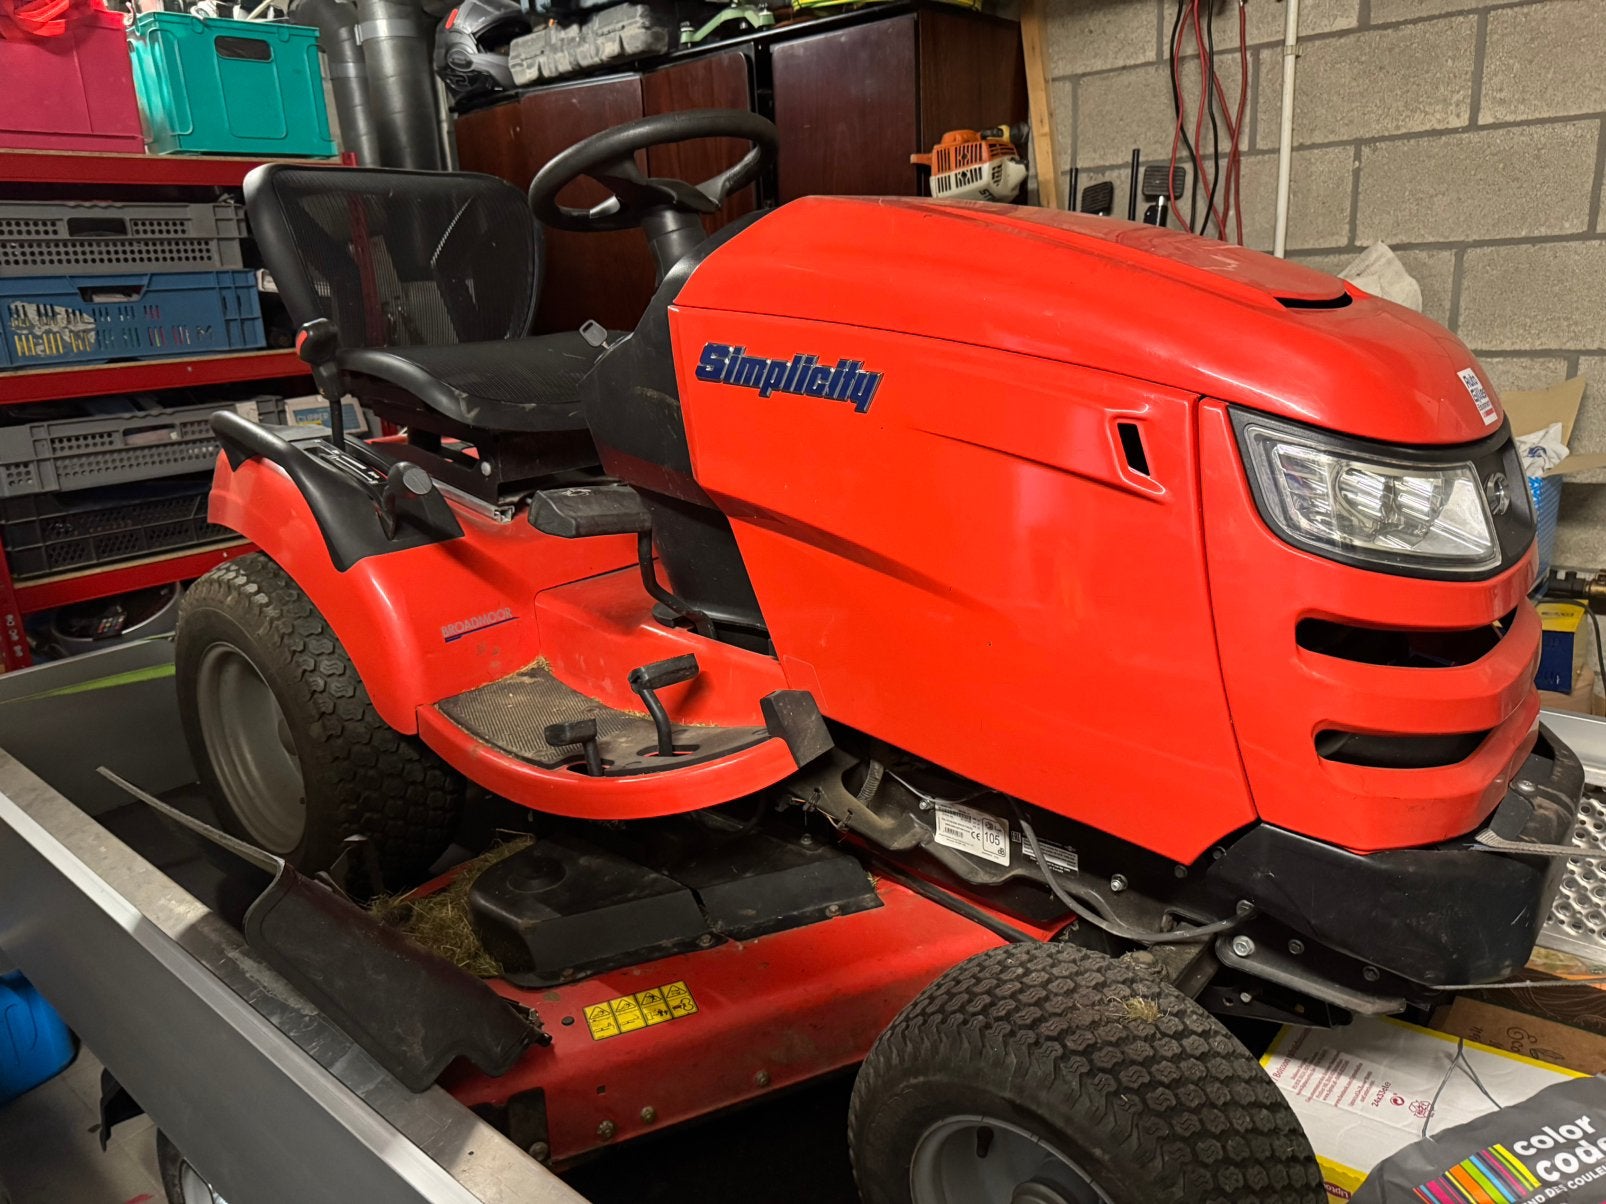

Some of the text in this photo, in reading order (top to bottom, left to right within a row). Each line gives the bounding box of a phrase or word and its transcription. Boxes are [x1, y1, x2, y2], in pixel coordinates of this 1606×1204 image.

[695, 342, 885, 414] Simplicity
[441, 607, 513, 638] BROADMOOR
[985, 831, 1001, 846] 105
[1513, 1115, 1596, 1156] color
[1544, 1184, 1568, 1198] DES
